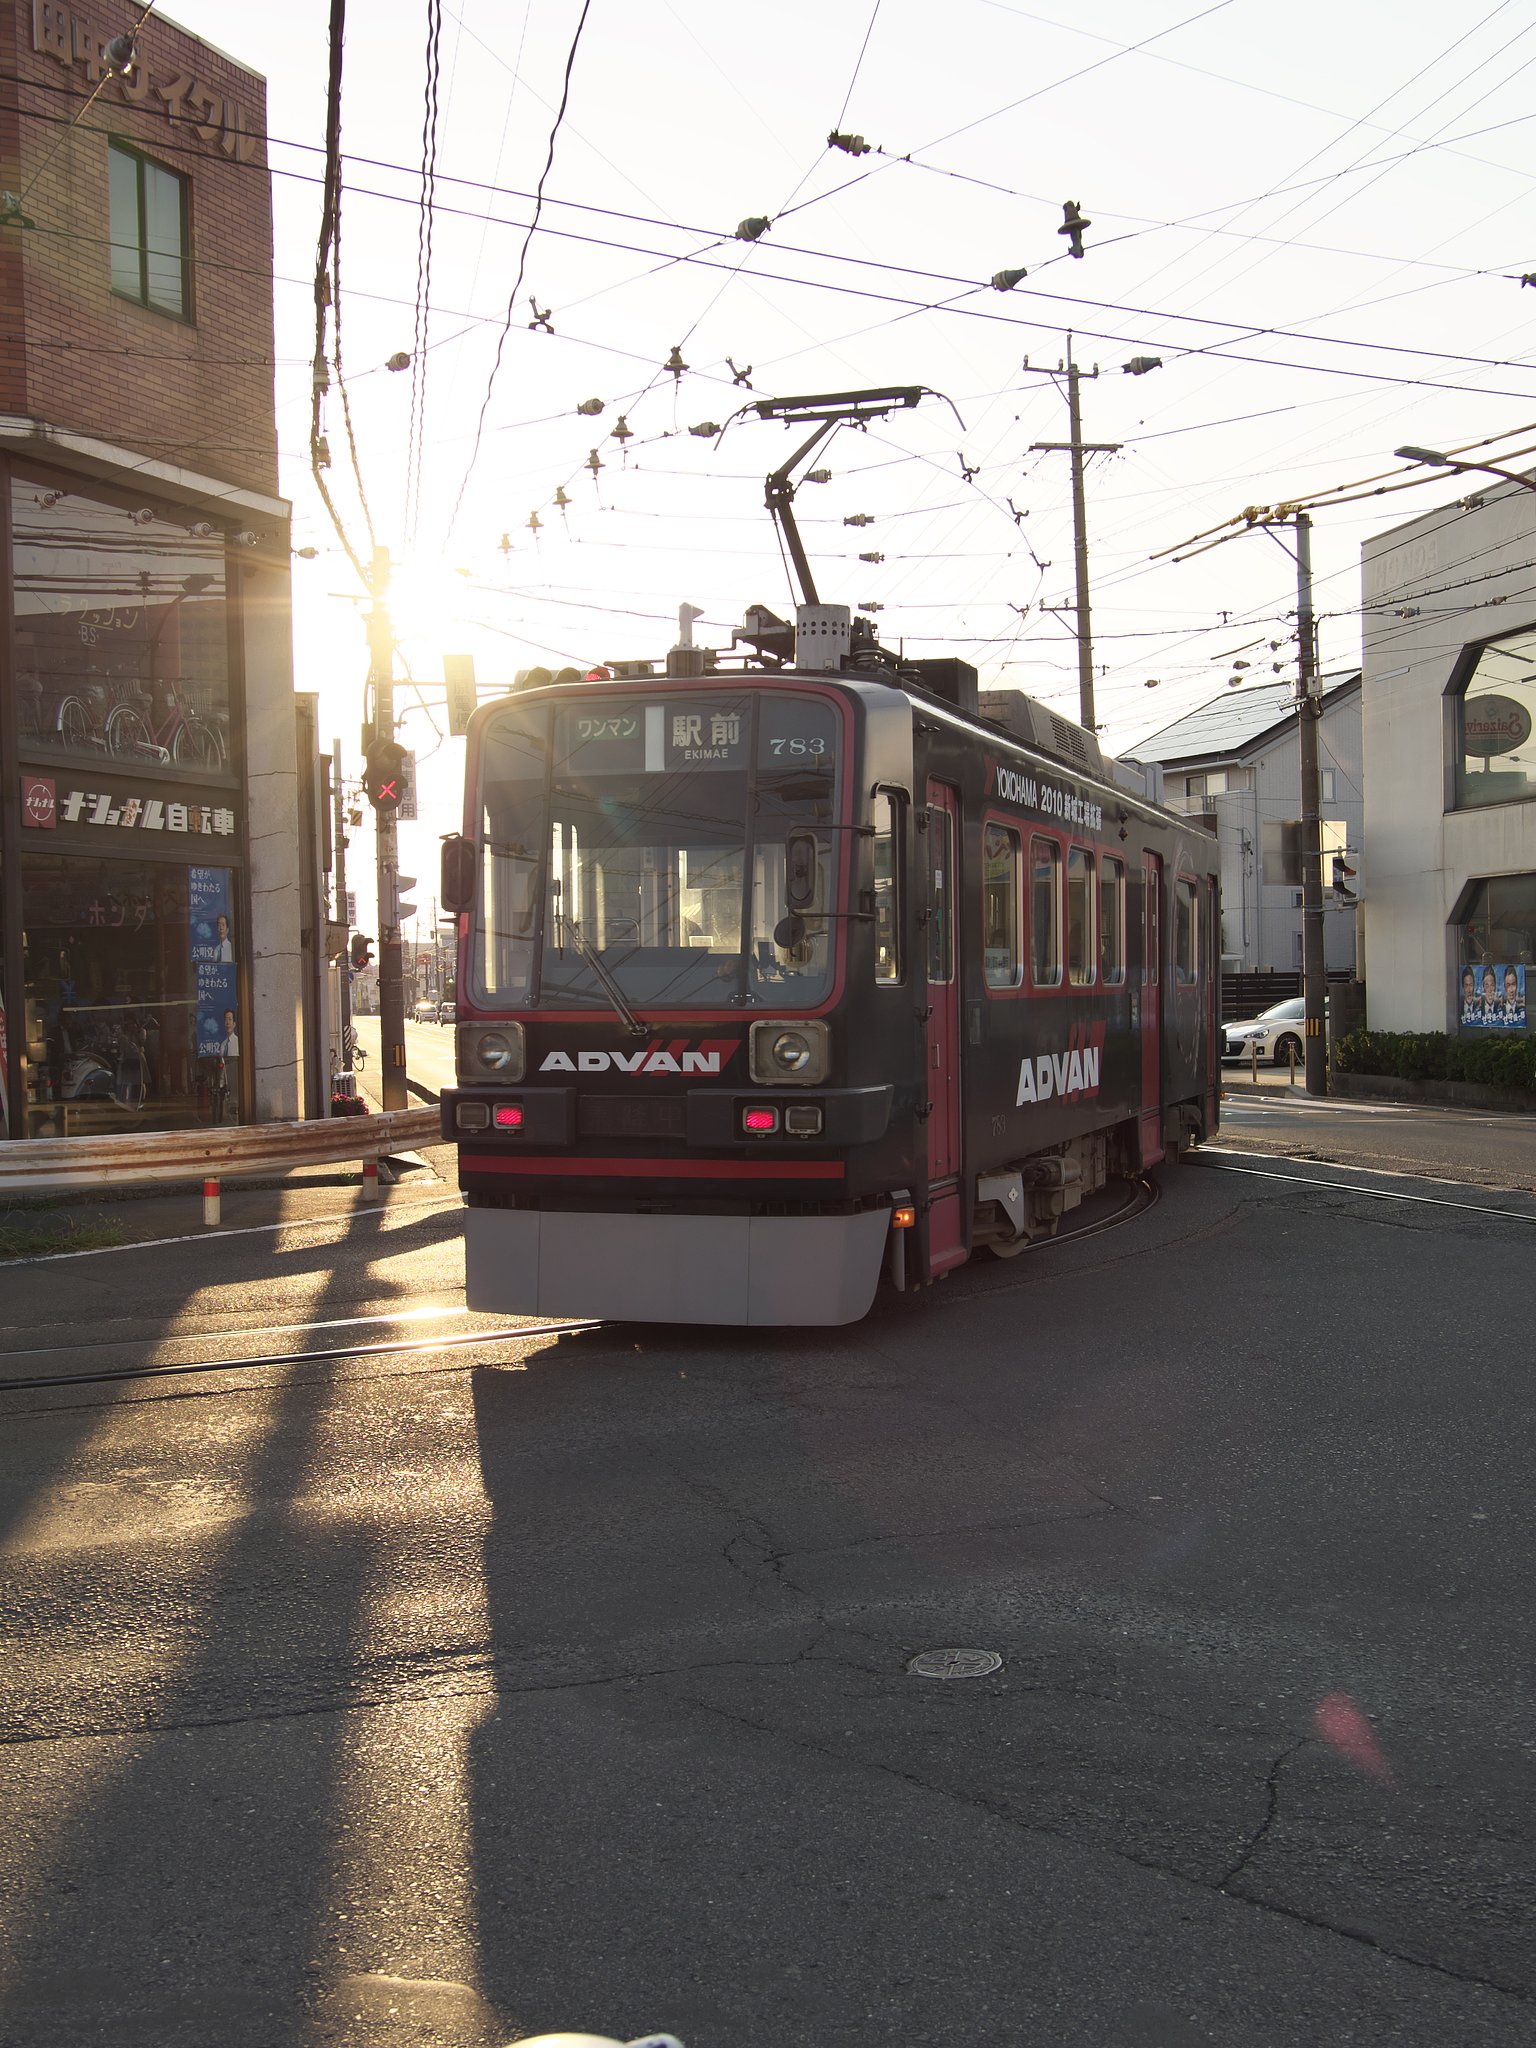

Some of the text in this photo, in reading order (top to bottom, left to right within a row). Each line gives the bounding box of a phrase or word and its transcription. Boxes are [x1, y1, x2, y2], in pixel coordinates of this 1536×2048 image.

[578, 718, 638, 738] ワンマン
[672, 712, 741, 747] 駅前
[684, 749, 729, 760] EKIMAE
[769, 738, 825, 755] 783
[996, 765, 1038, 810] YOKOHAMA
[1040, 784, 1062, 817] 2010
[60, 791, 235, 835] ナショナル自転車
[88, 900, 153, 932] ホンダ
[192, 946, 214, 959] 公明党
[199, 1042, 221, 1054] 公明党
[539, 1052, 720, 1072] ADVAN
[1016, 1046, 1100, 1107] ADVAN
